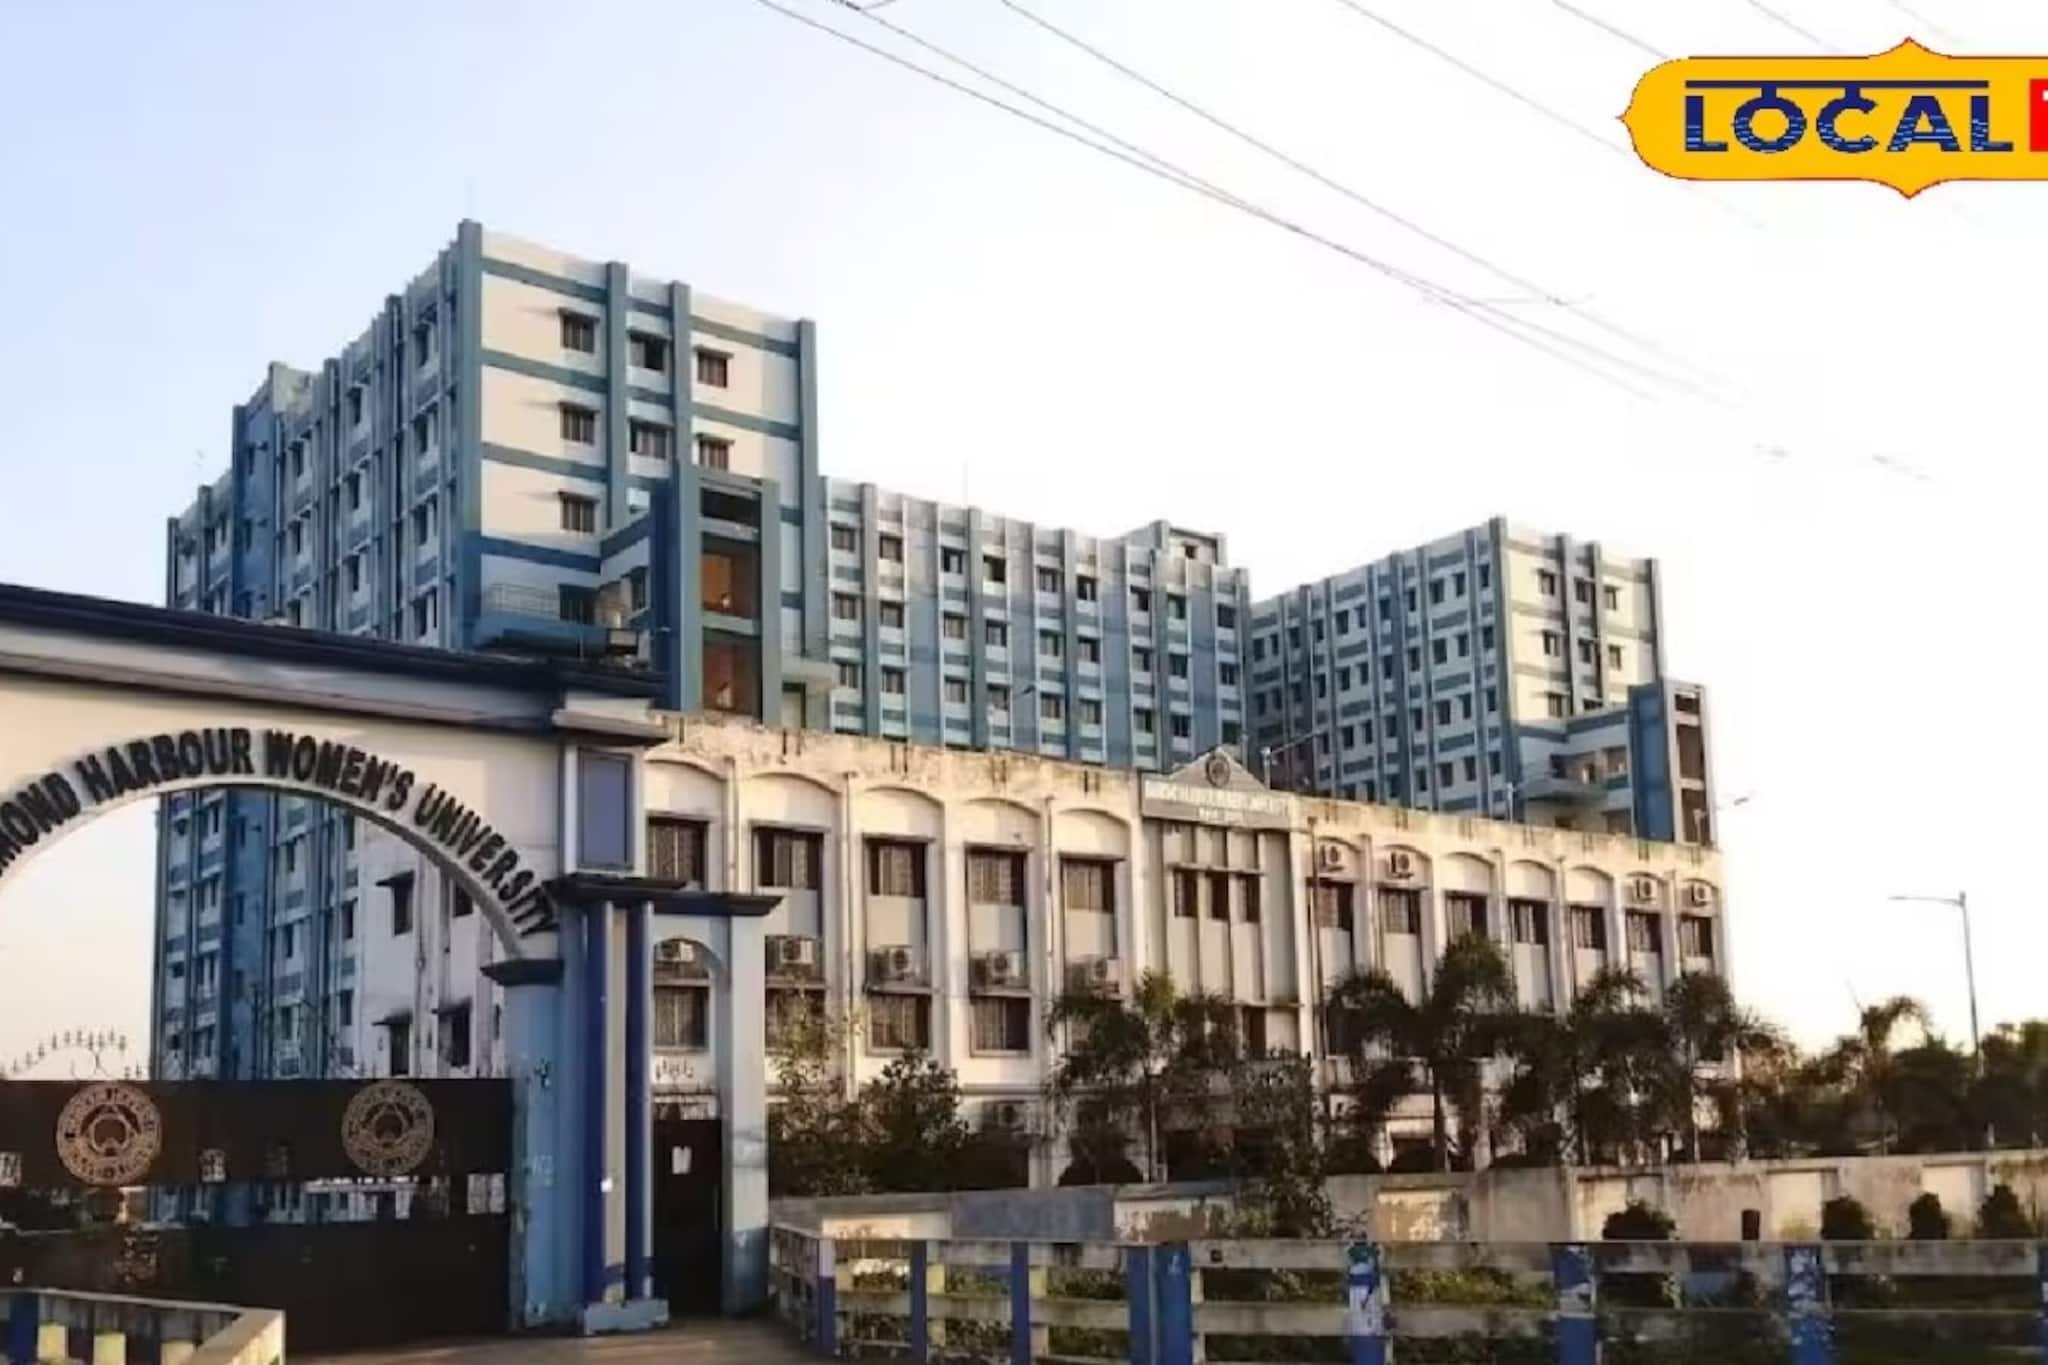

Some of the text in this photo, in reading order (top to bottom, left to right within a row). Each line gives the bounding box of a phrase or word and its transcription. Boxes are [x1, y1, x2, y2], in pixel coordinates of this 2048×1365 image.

[0, 727, 560, 938] MOND HARBOUR WOMEN'S UNIVERSITY
